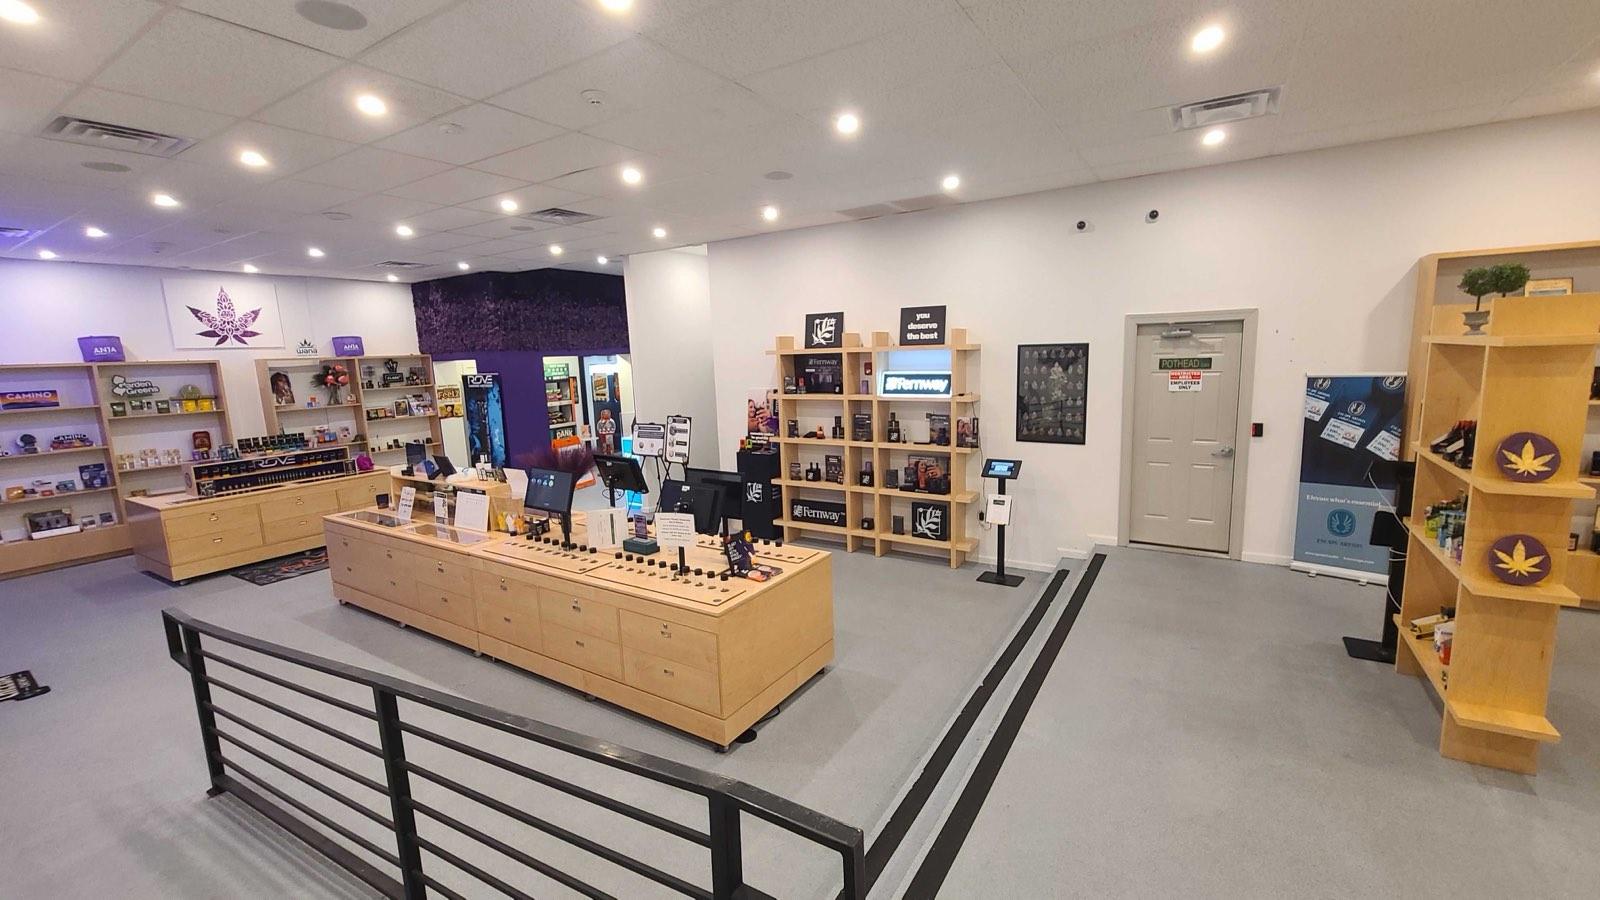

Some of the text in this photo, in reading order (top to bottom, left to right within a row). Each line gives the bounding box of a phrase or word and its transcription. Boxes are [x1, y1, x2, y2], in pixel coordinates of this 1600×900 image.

[916, 313, 930, 321] you
[907, 322, 938, 330] deserve
[907, 331, 938, 340] the best
[1162, 359, 1200, 368] POTHEAD
[467, 375, 493, 385] ROVE
[898, 376, 949, 392] Fernway
[6, 391, 52, 400] CAMINO
[253, 456, 297, 468] ROVE
[803, 506, 840, 523] Fernway
